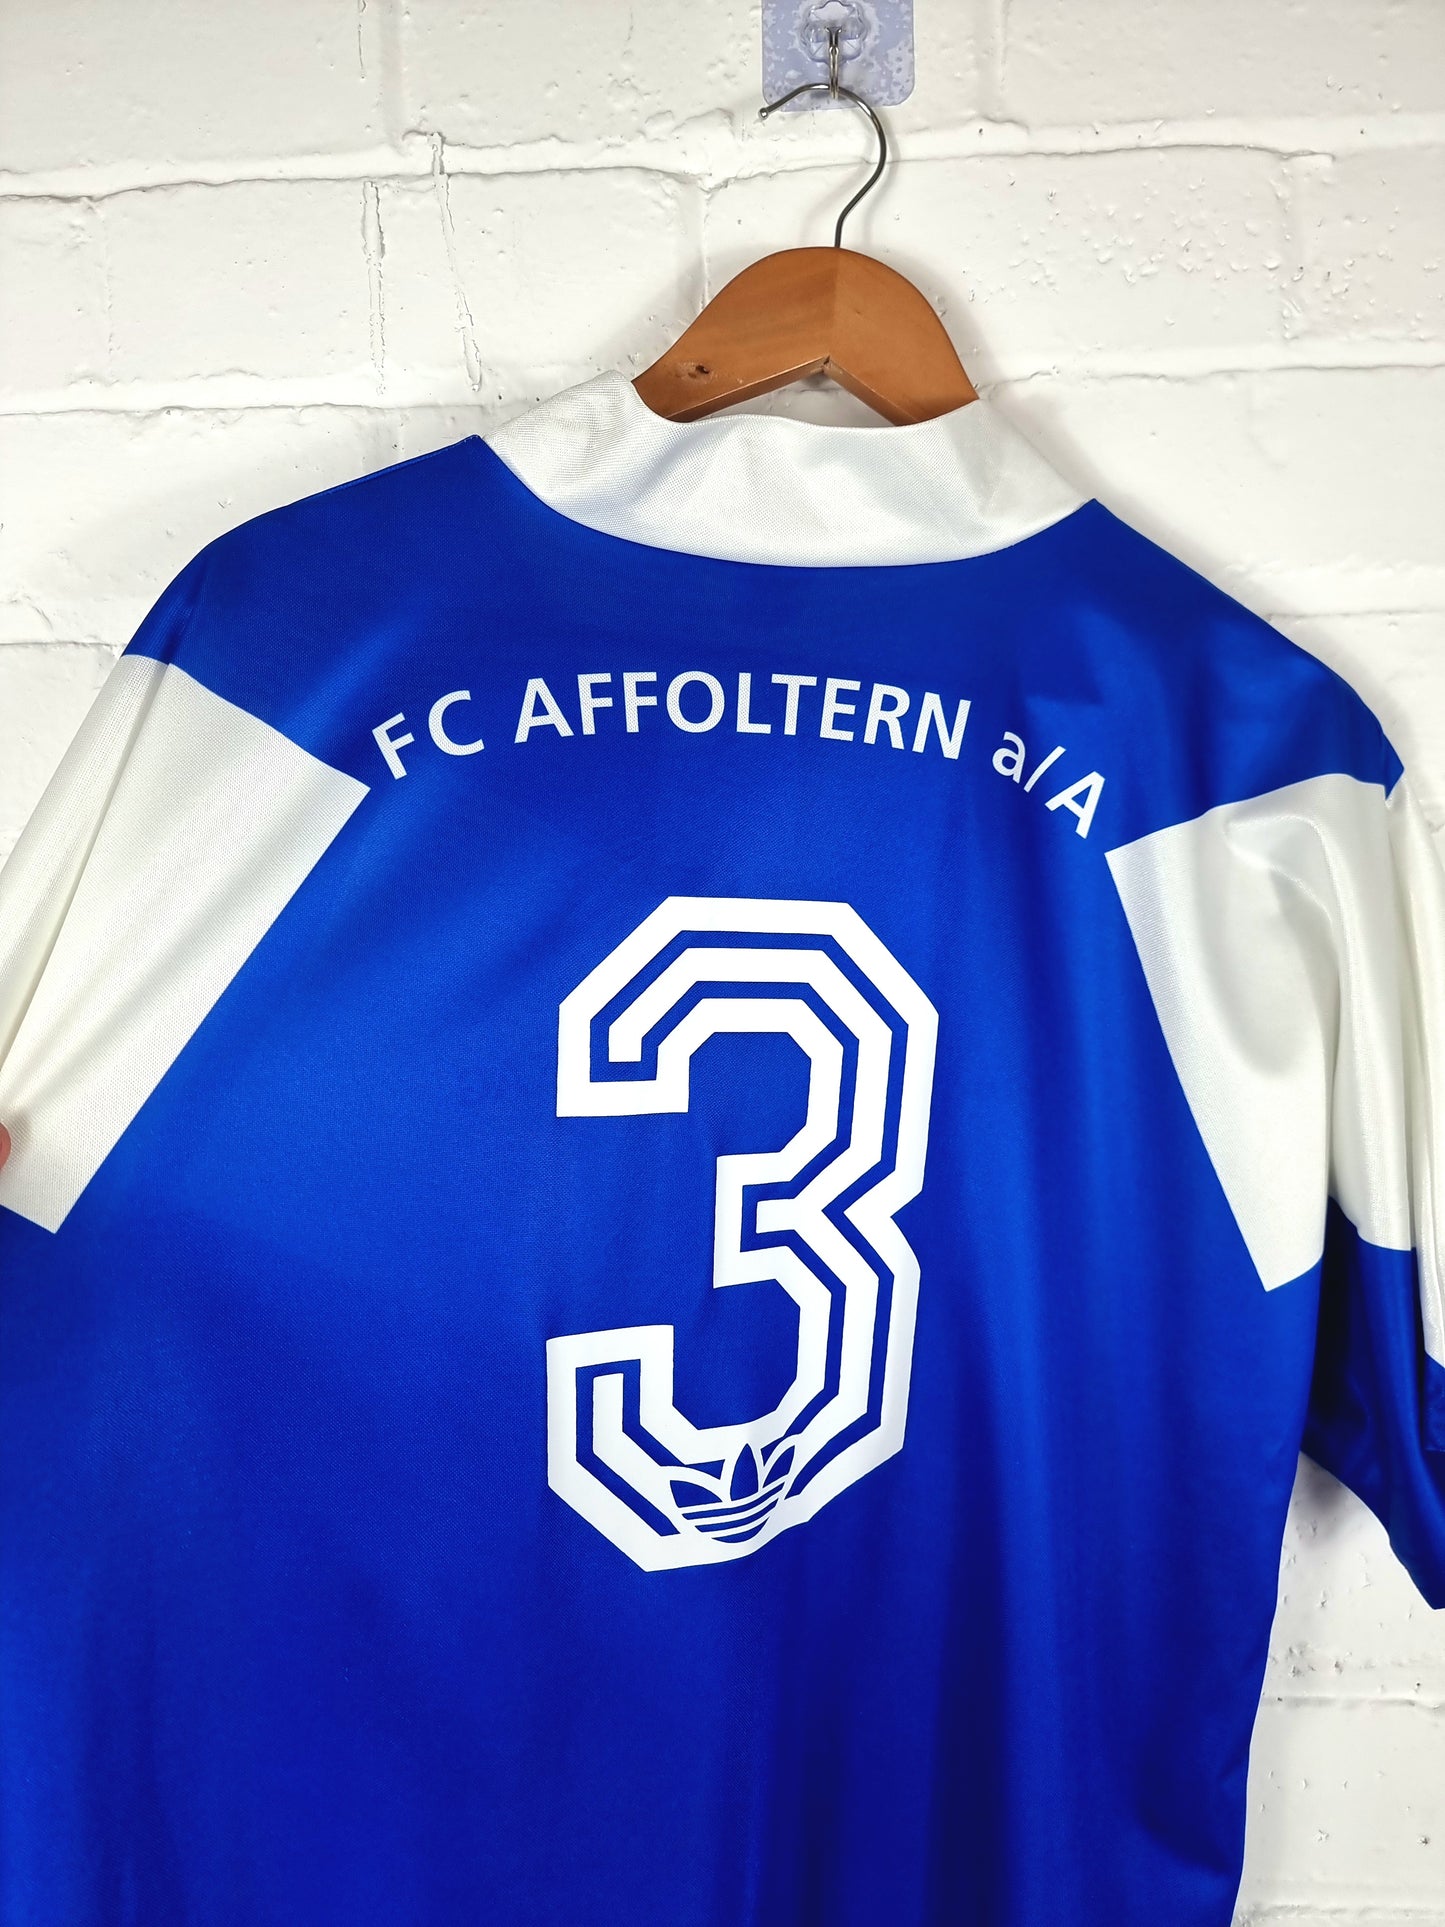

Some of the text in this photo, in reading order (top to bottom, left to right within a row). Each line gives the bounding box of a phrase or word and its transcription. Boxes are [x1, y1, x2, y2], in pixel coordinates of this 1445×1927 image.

[372, 690, 485, 780] FC
[514, 670, 971, 760] AFFOLTERN
[545, 896, 939, 1572] 3
